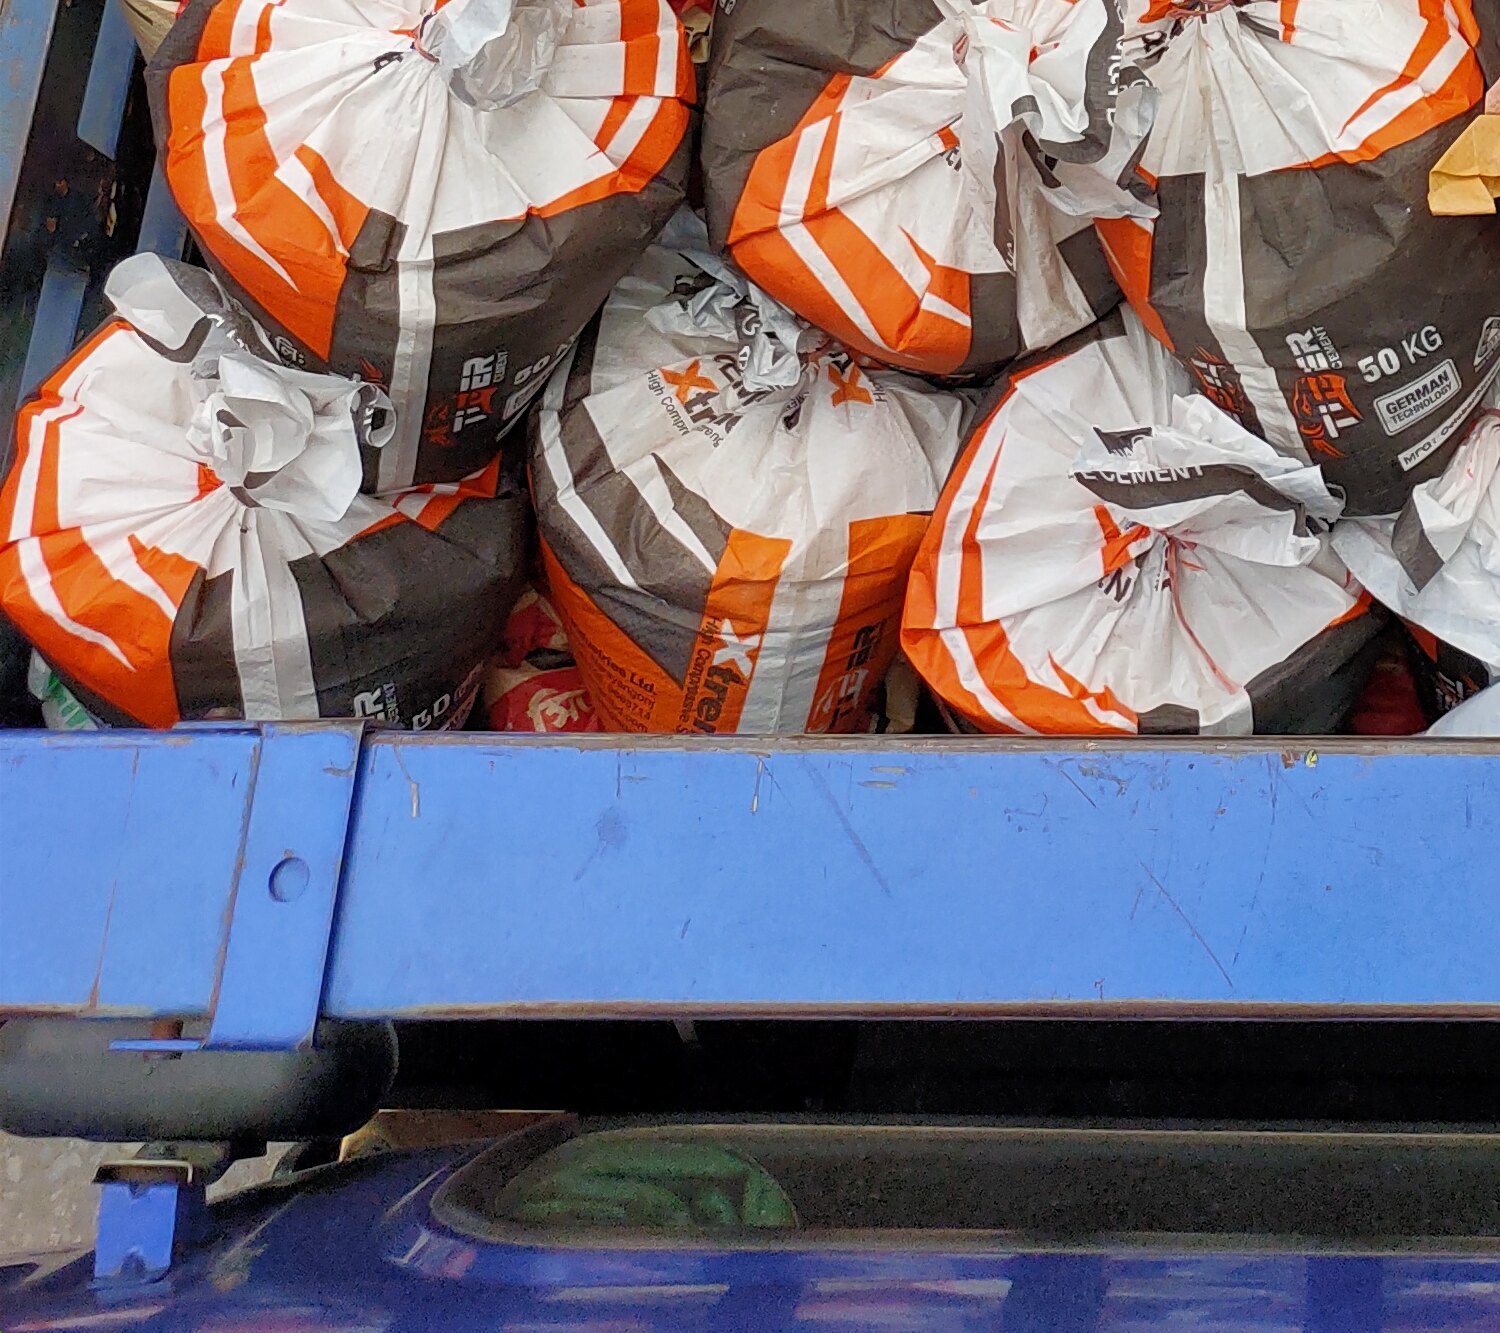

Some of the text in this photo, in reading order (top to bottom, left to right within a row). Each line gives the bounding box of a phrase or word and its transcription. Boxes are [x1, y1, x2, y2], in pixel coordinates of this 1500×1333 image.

[1356, 324, 1445, 383] 50 KG
[645, 368, 665, 401] High
[1384, 370, 1451, 416] GERMAN
[1389, 381, 1454, 426] TECHNOLOGY
